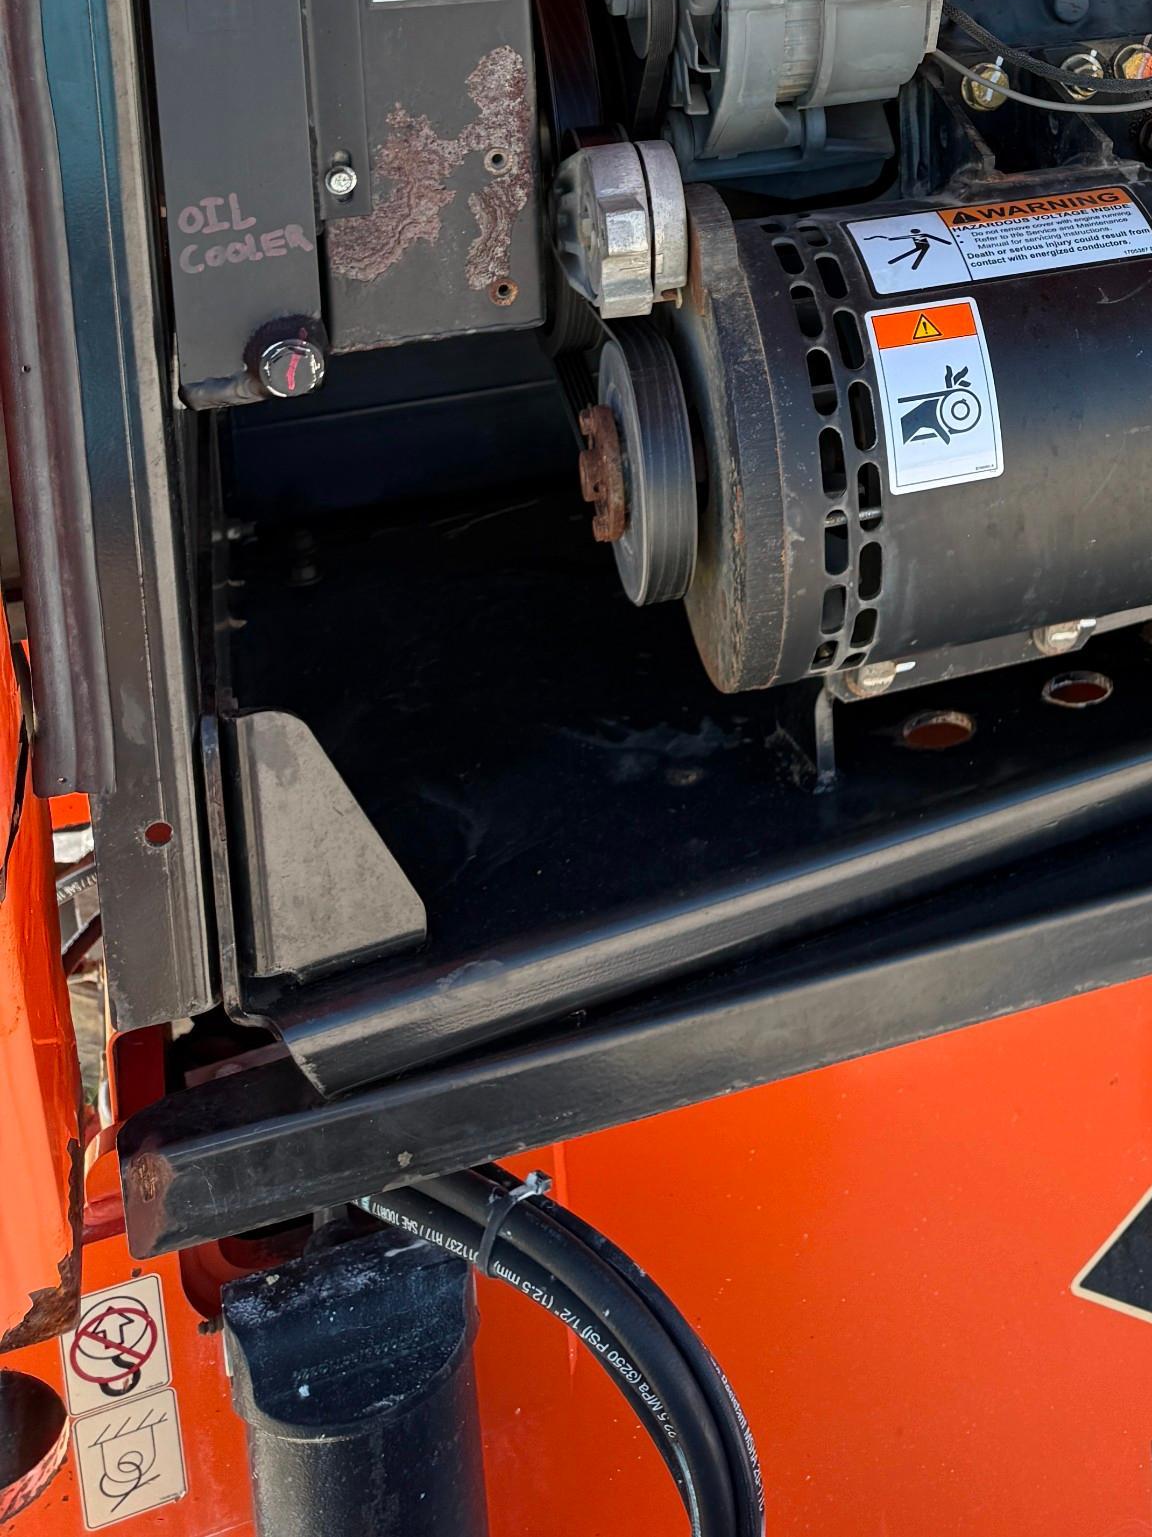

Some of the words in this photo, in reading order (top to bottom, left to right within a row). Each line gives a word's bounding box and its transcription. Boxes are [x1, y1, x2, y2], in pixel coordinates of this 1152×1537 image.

[177, 192, 256, 234] OIL
[952, 218, 1030, 232] HAZARDOUS
[1033, 210, 1088, 220] VOLTAGE
[1091, 204, 1131, 212] INSIDE
[977, 192, 1119, 218] WARNING
[1024, 233, 1061, 243] servicing
[1063, 227, 1112, 237] instructions.
[1076, 218, 1128, 228] Maintenance
[179, 224, 313, 273] COOLER
[967, 251, 995, 259] Death
[1009, 245, 1043, 254] serious
[1045, 240, 1071, 248] injury
[1074, 235, 1099, 243] could
[1102, 231, 1127, 240] result
[971, 258, 1006, 267] contact
[1008, 254, 1028, 262] with
[1030, 247, 1074, 259] energized
[1077, 240, 1131, 251] conductors.
[372, 1202, 399, 1225] 100R17
[402, 1216, 418, 1234] SAE
[425, 1225, 443, 1246] R17
[494, 1260, 520, 1285] mm)
[522, 1282, 554, 1309] (12.5
[580, 1326, 609, 1352] PSI)
[607, 1351, 642, 1384] (3250
[638, 1382, 664, 1412] MPa
